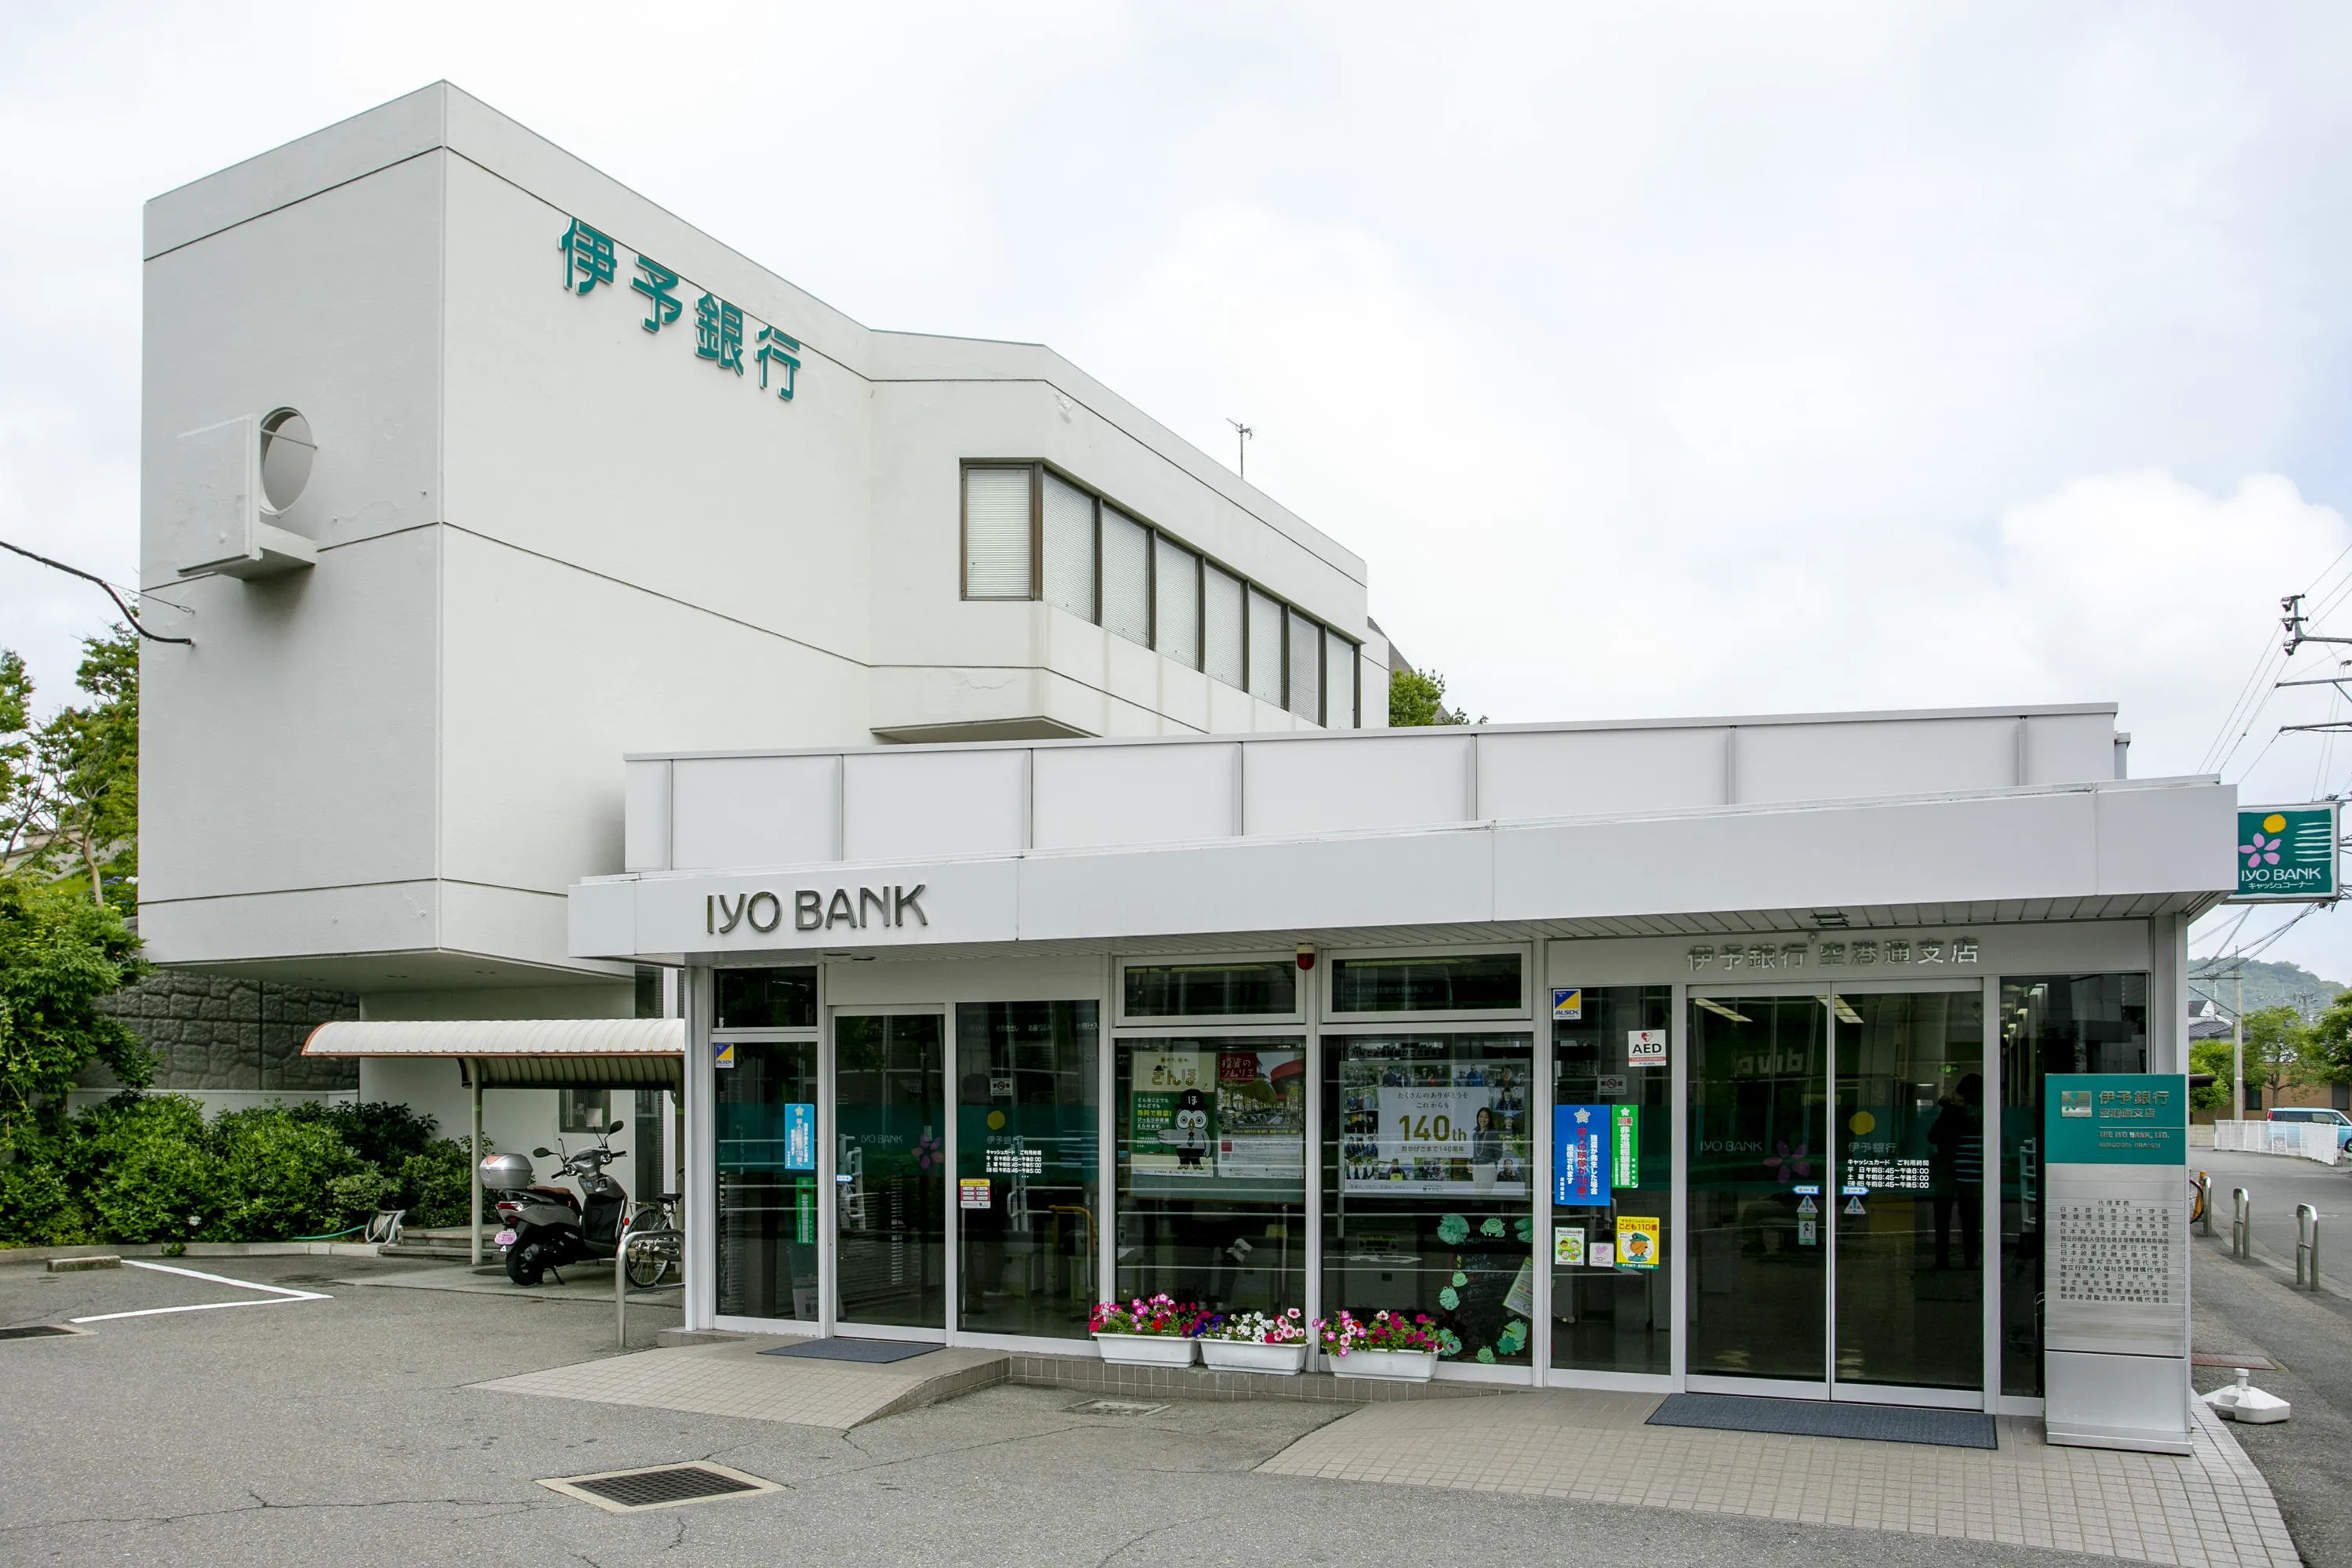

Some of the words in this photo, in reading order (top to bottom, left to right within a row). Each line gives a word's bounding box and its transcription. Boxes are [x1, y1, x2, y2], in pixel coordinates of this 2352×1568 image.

[557, 216, 801, 401] 伊予銀行
[2241, 869, 2270, 882] IYO
[2274, 868, 2321, 880] BANK
[707, 891, 783, 935] IYO
[795, 884, 928, 931] BANK
[1687, 943, 1808, 971] 伊予銀行
[1818, 937, 1979, 967] 空港通支店
[1632, 1044, 1661, 1054] AED
[2099, 1091, 2169, 1105] 伊予銀行
[1399, 1115, 1467, 1142] 140th
[1726, 1141, 1763, 1152] BANK
[1849, 1142, 1896, 1153] 伊予銀行
